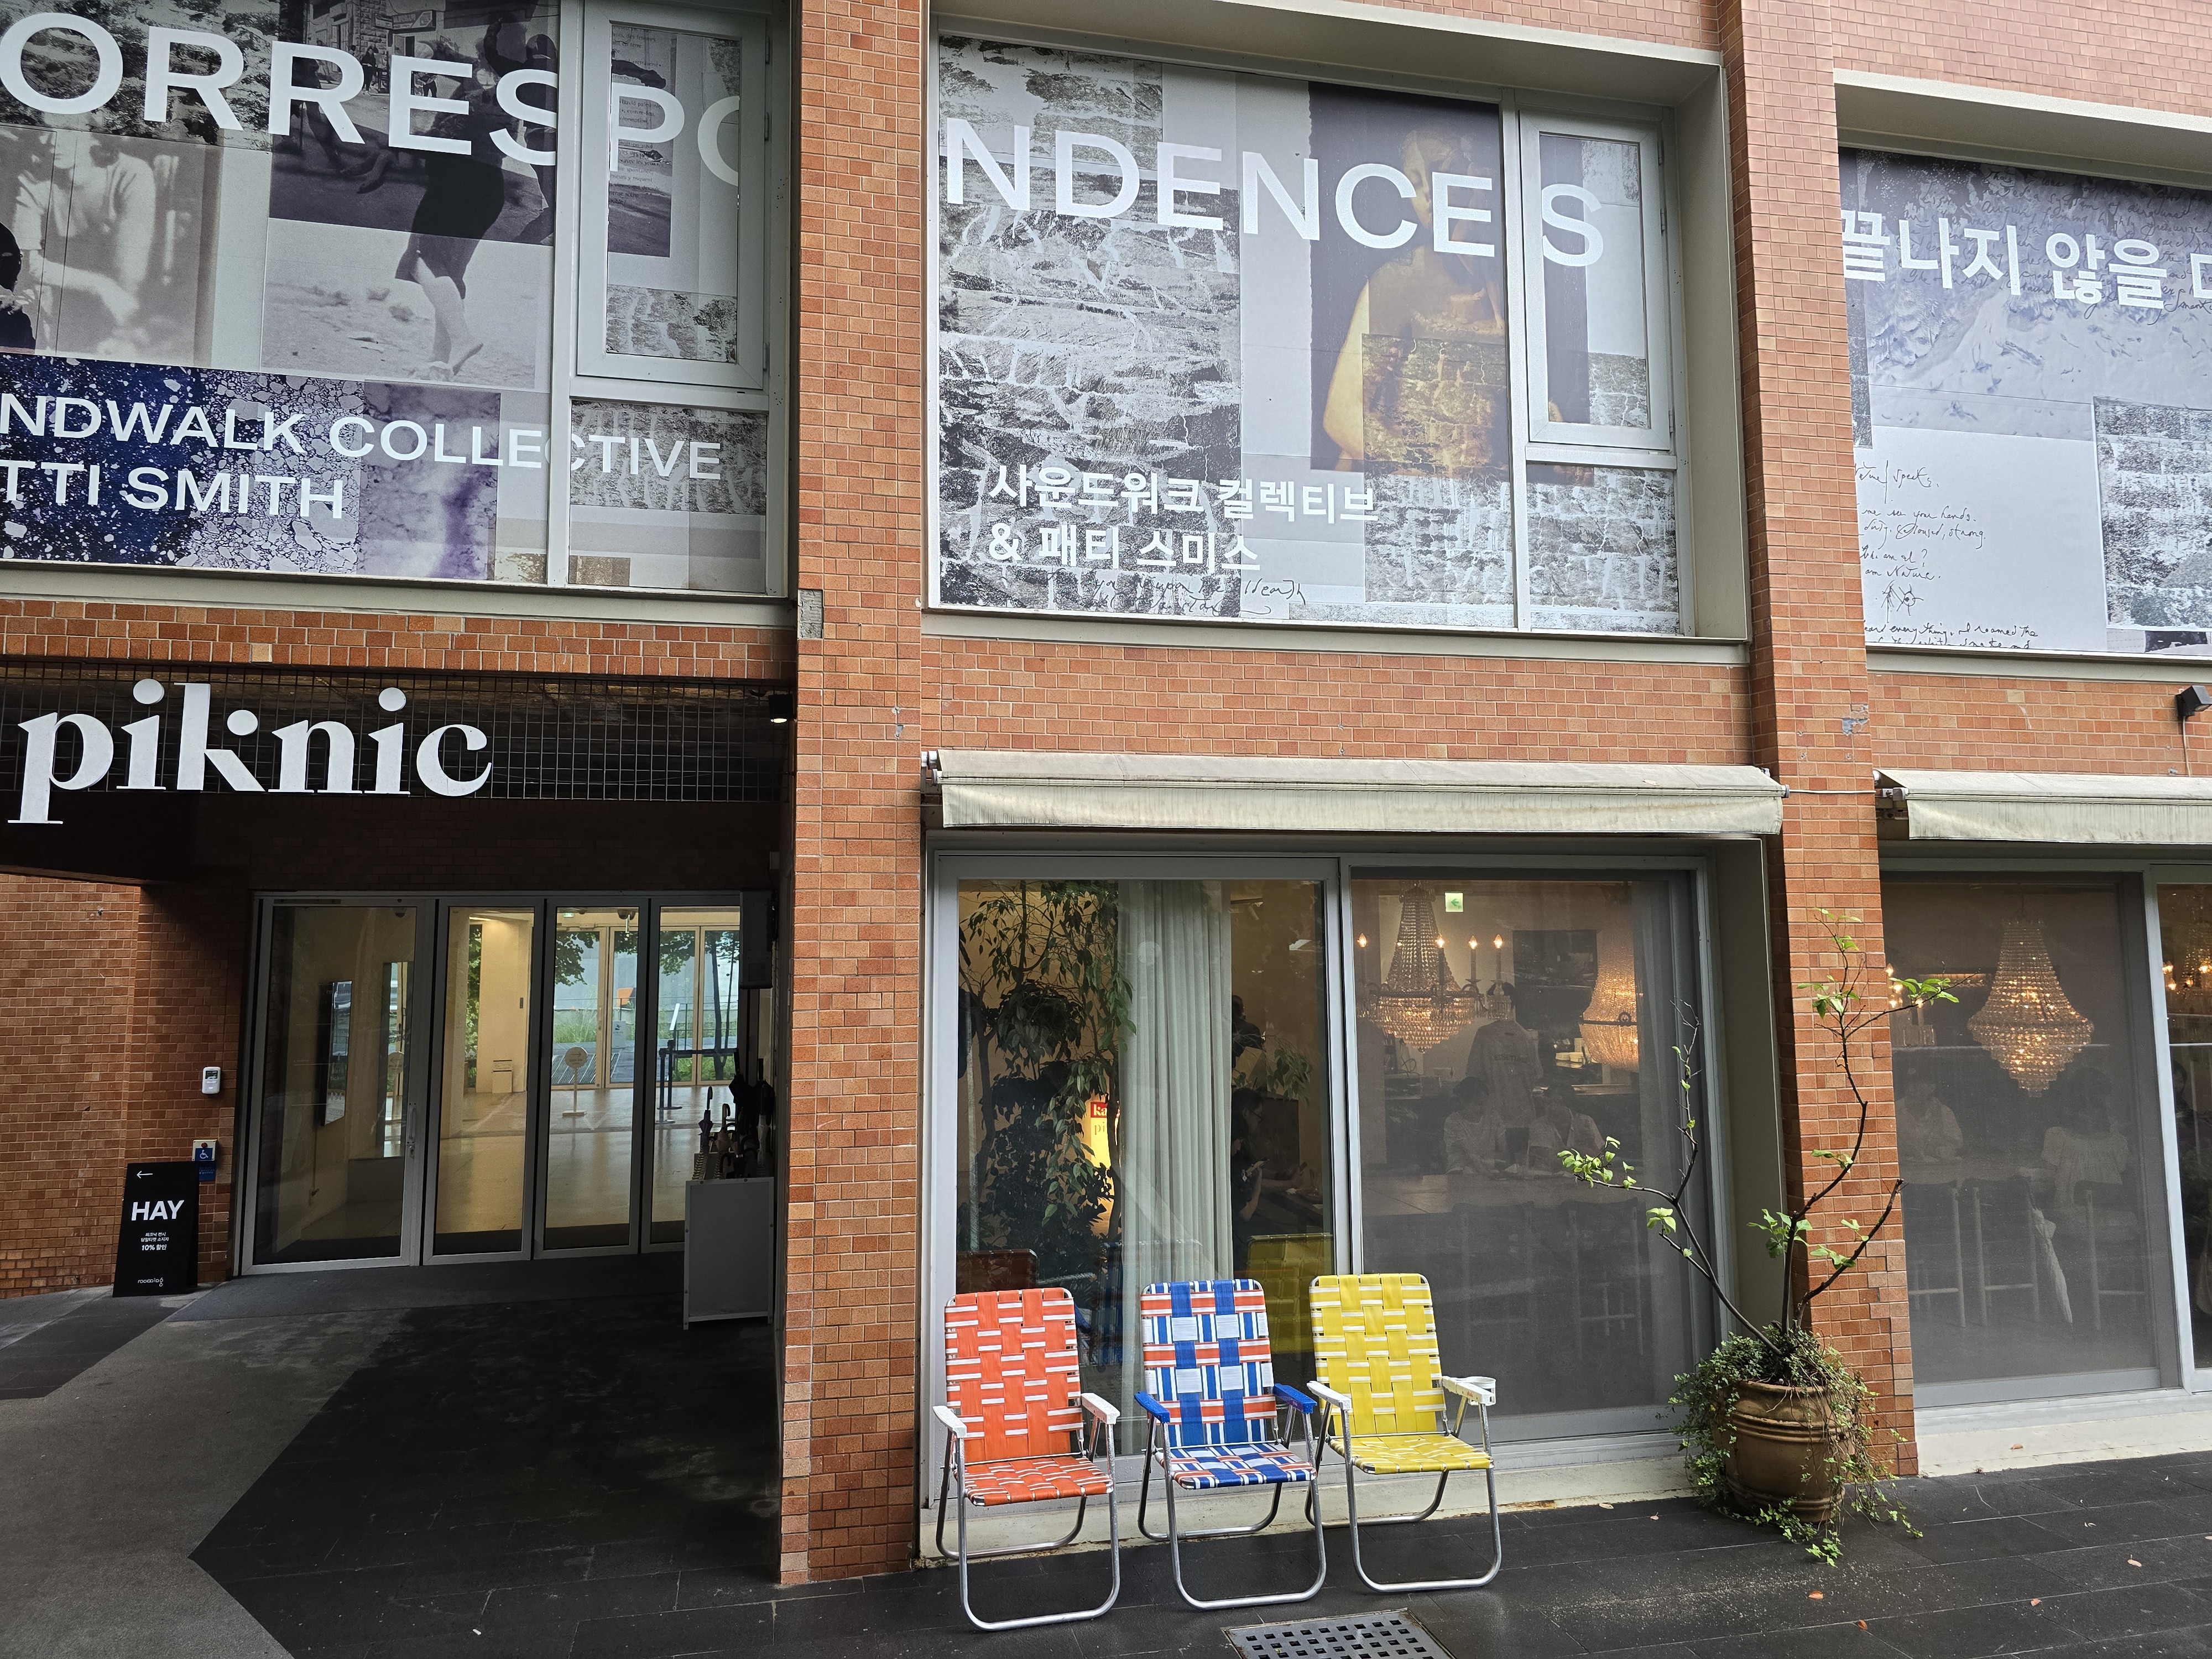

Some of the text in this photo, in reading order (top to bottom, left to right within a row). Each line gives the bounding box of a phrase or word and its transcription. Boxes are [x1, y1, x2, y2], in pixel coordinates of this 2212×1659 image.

[947, 117, 1604, 267] NDENCES
[1841, 210, 2021, 296] 끝나지
[2045, 232, 2167, 310] 않을
[0, 393, 721, 480] NDWALK COLLECTIVE
[125, 467, 343, 519] SMITH
[989, 463, 1379, 524] 사운드워크 컬렉티브
[989, 521, 1260, 572] & 패티 스미스
[8, 679, 492, 824] piknic
[1093, 1104, 1107, 1116] ka
[131, 1199, 185, 1221] HAY
